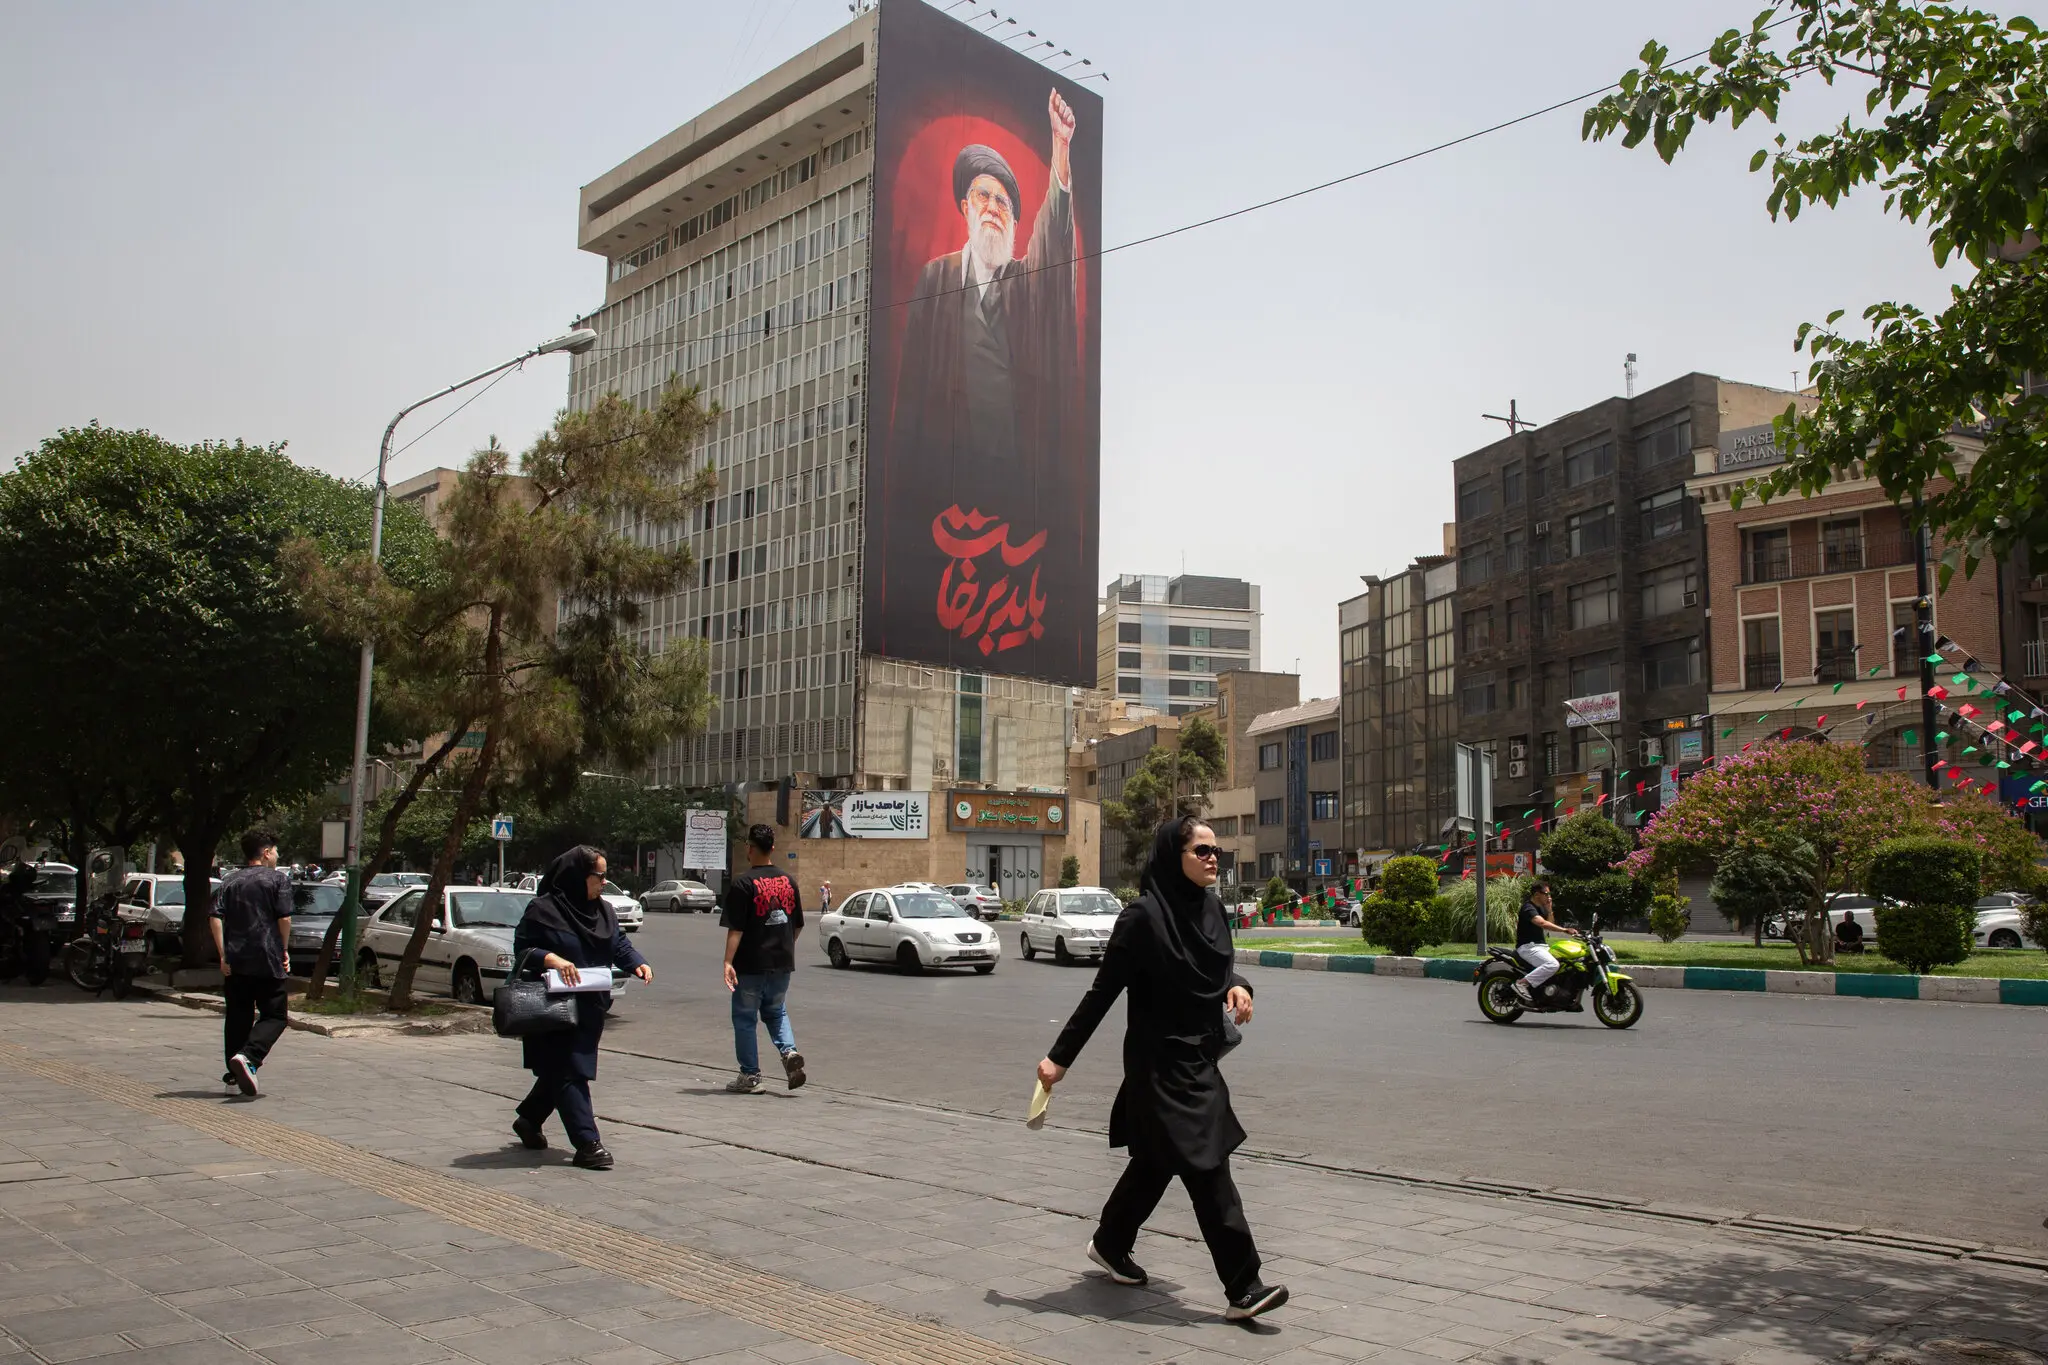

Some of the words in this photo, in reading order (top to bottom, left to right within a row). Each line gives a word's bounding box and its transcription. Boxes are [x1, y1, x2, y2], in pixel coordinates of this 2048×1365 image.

[1723, 444, 1787, 465] EXCHANG
[932, 504, 1047, 656] برخاست
[851, 800, 875, 812] بازار
[2029, 796, 2048, 807] GE
[753, 876, 791, 894] NEVER
